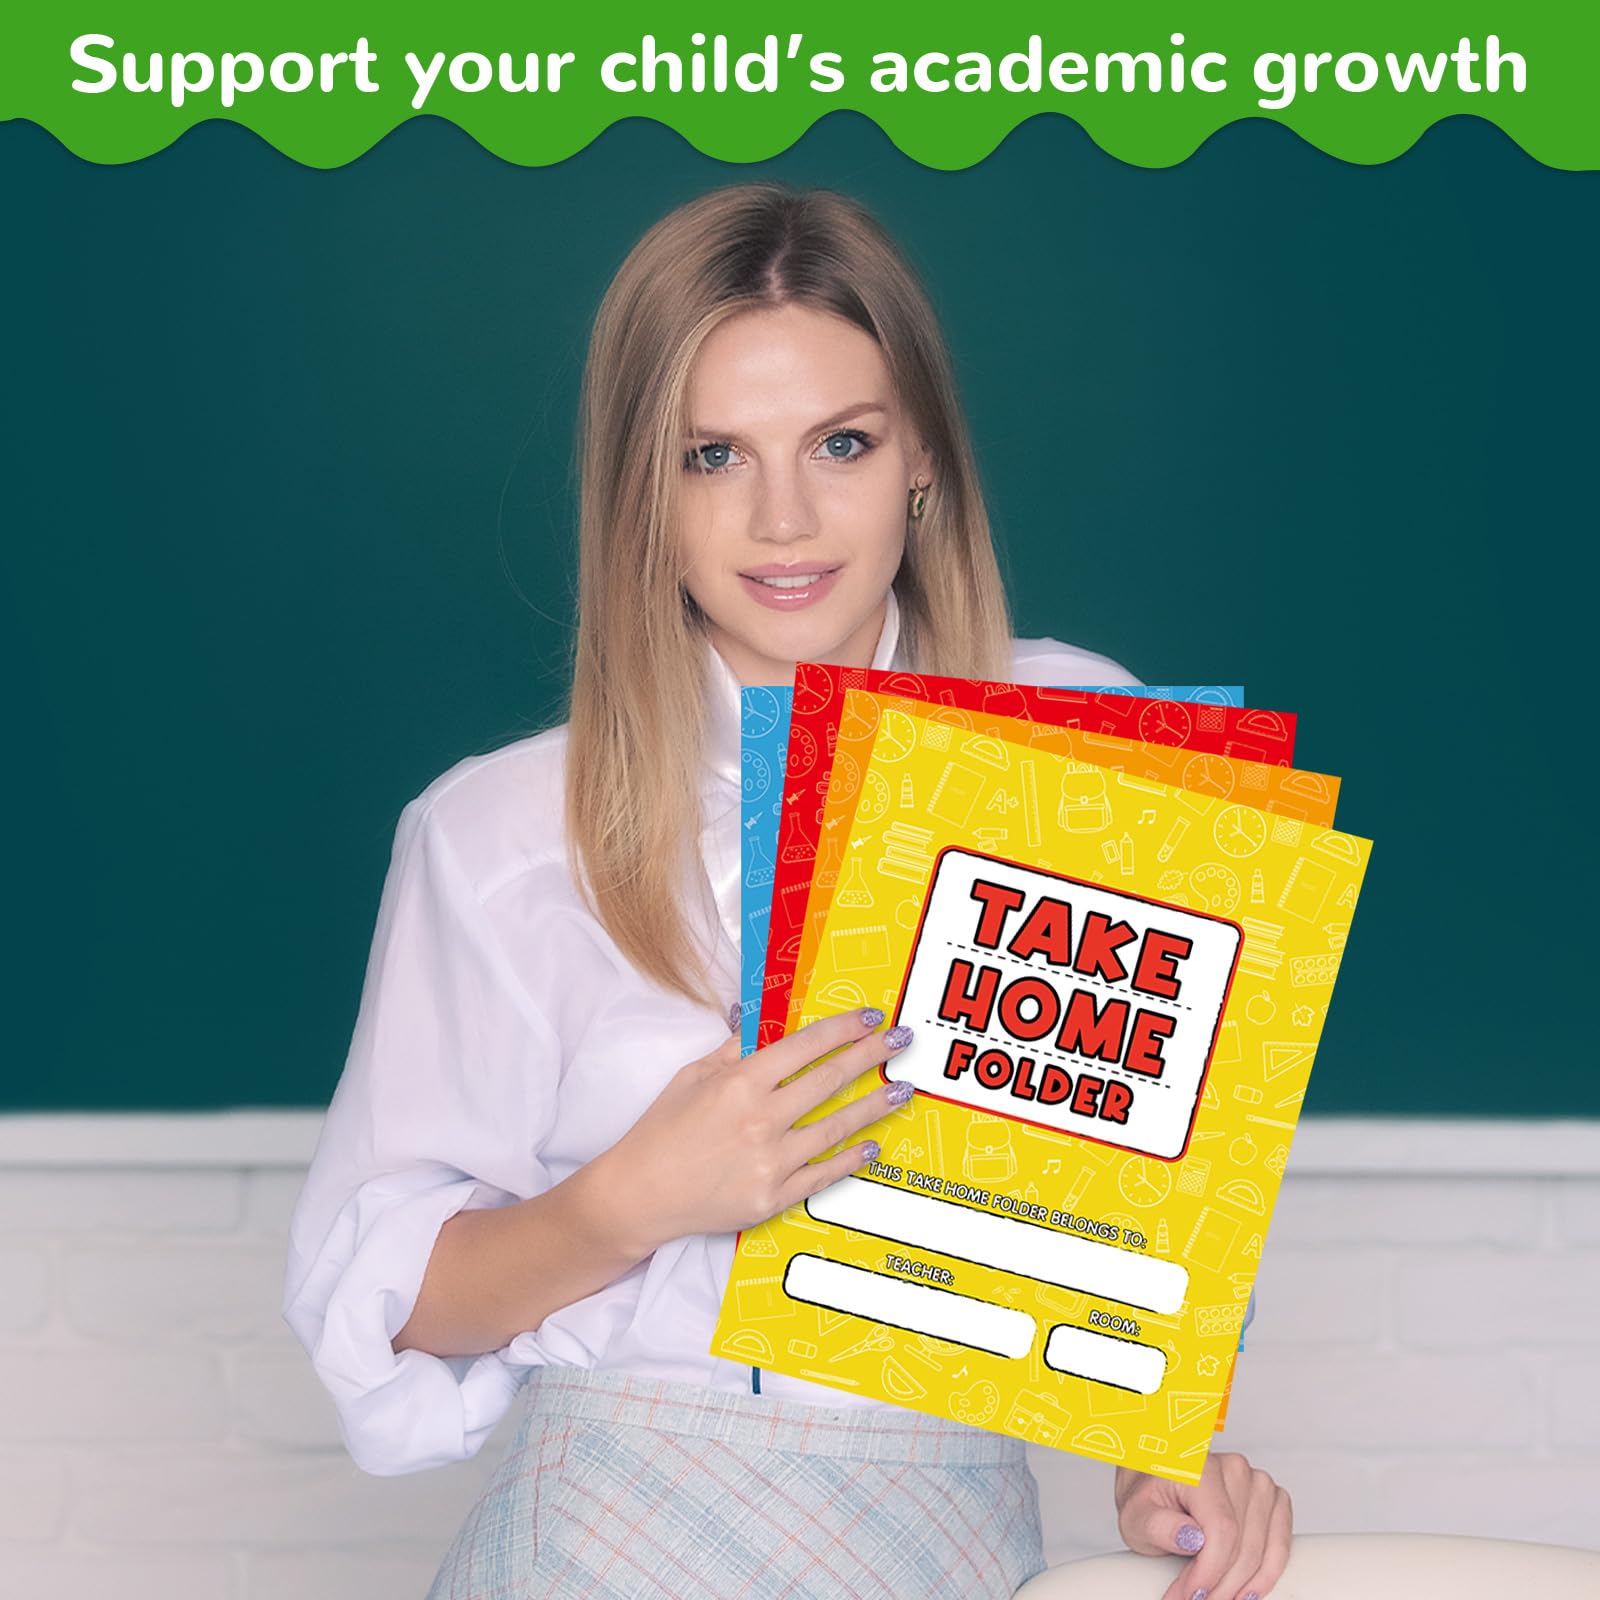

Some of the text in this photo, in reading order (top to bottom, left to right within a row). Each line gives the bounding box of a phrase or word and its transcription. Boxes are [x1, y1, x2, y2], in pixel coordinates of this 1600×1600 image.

[970, 879, 1193, 1000] TAKE
[938, 959, 1177, 1078] HOME
[944, 1039, 1133, 1124] FOLDER
[869, 1160, 1148, 1249] THIS TAKE HOME FOLDER BELONGS TO:
[886, 1253, 955, 1286] TEACHER:
[1088, 1309, 1141, 1336] ROOM:
